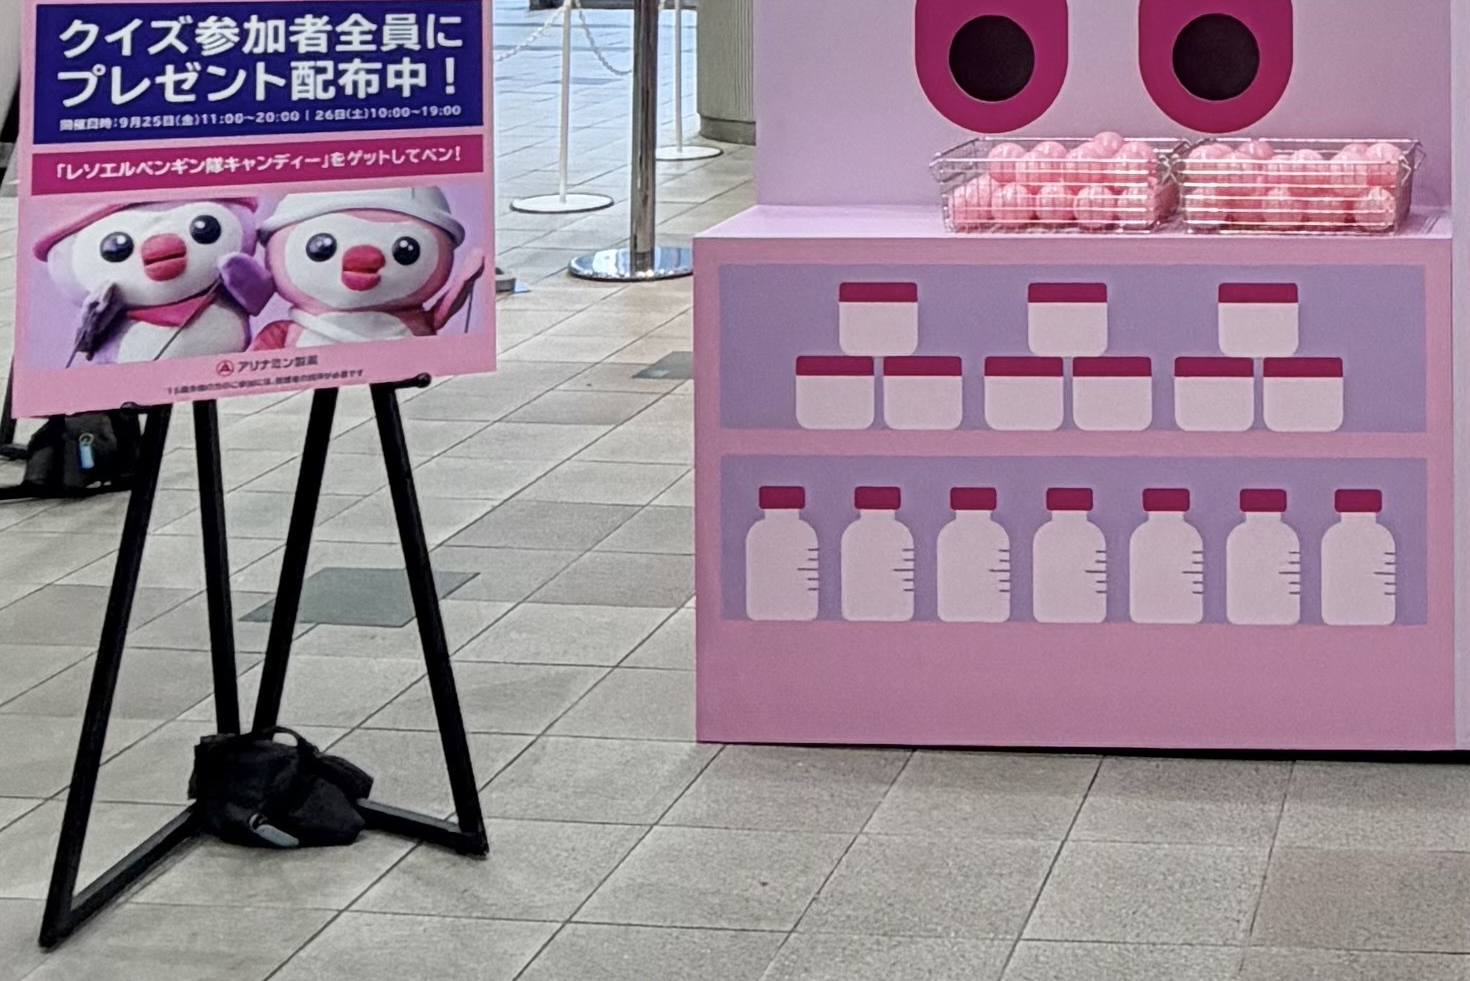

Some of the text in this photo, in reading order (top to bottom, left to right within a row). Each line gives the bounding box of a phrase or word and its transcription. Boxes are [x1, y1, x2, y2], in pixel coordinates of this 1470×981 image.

[58, 12, 463, 57] クイズ参加者全員に
[56, 58, 458, 108] プレゼント配布中!
